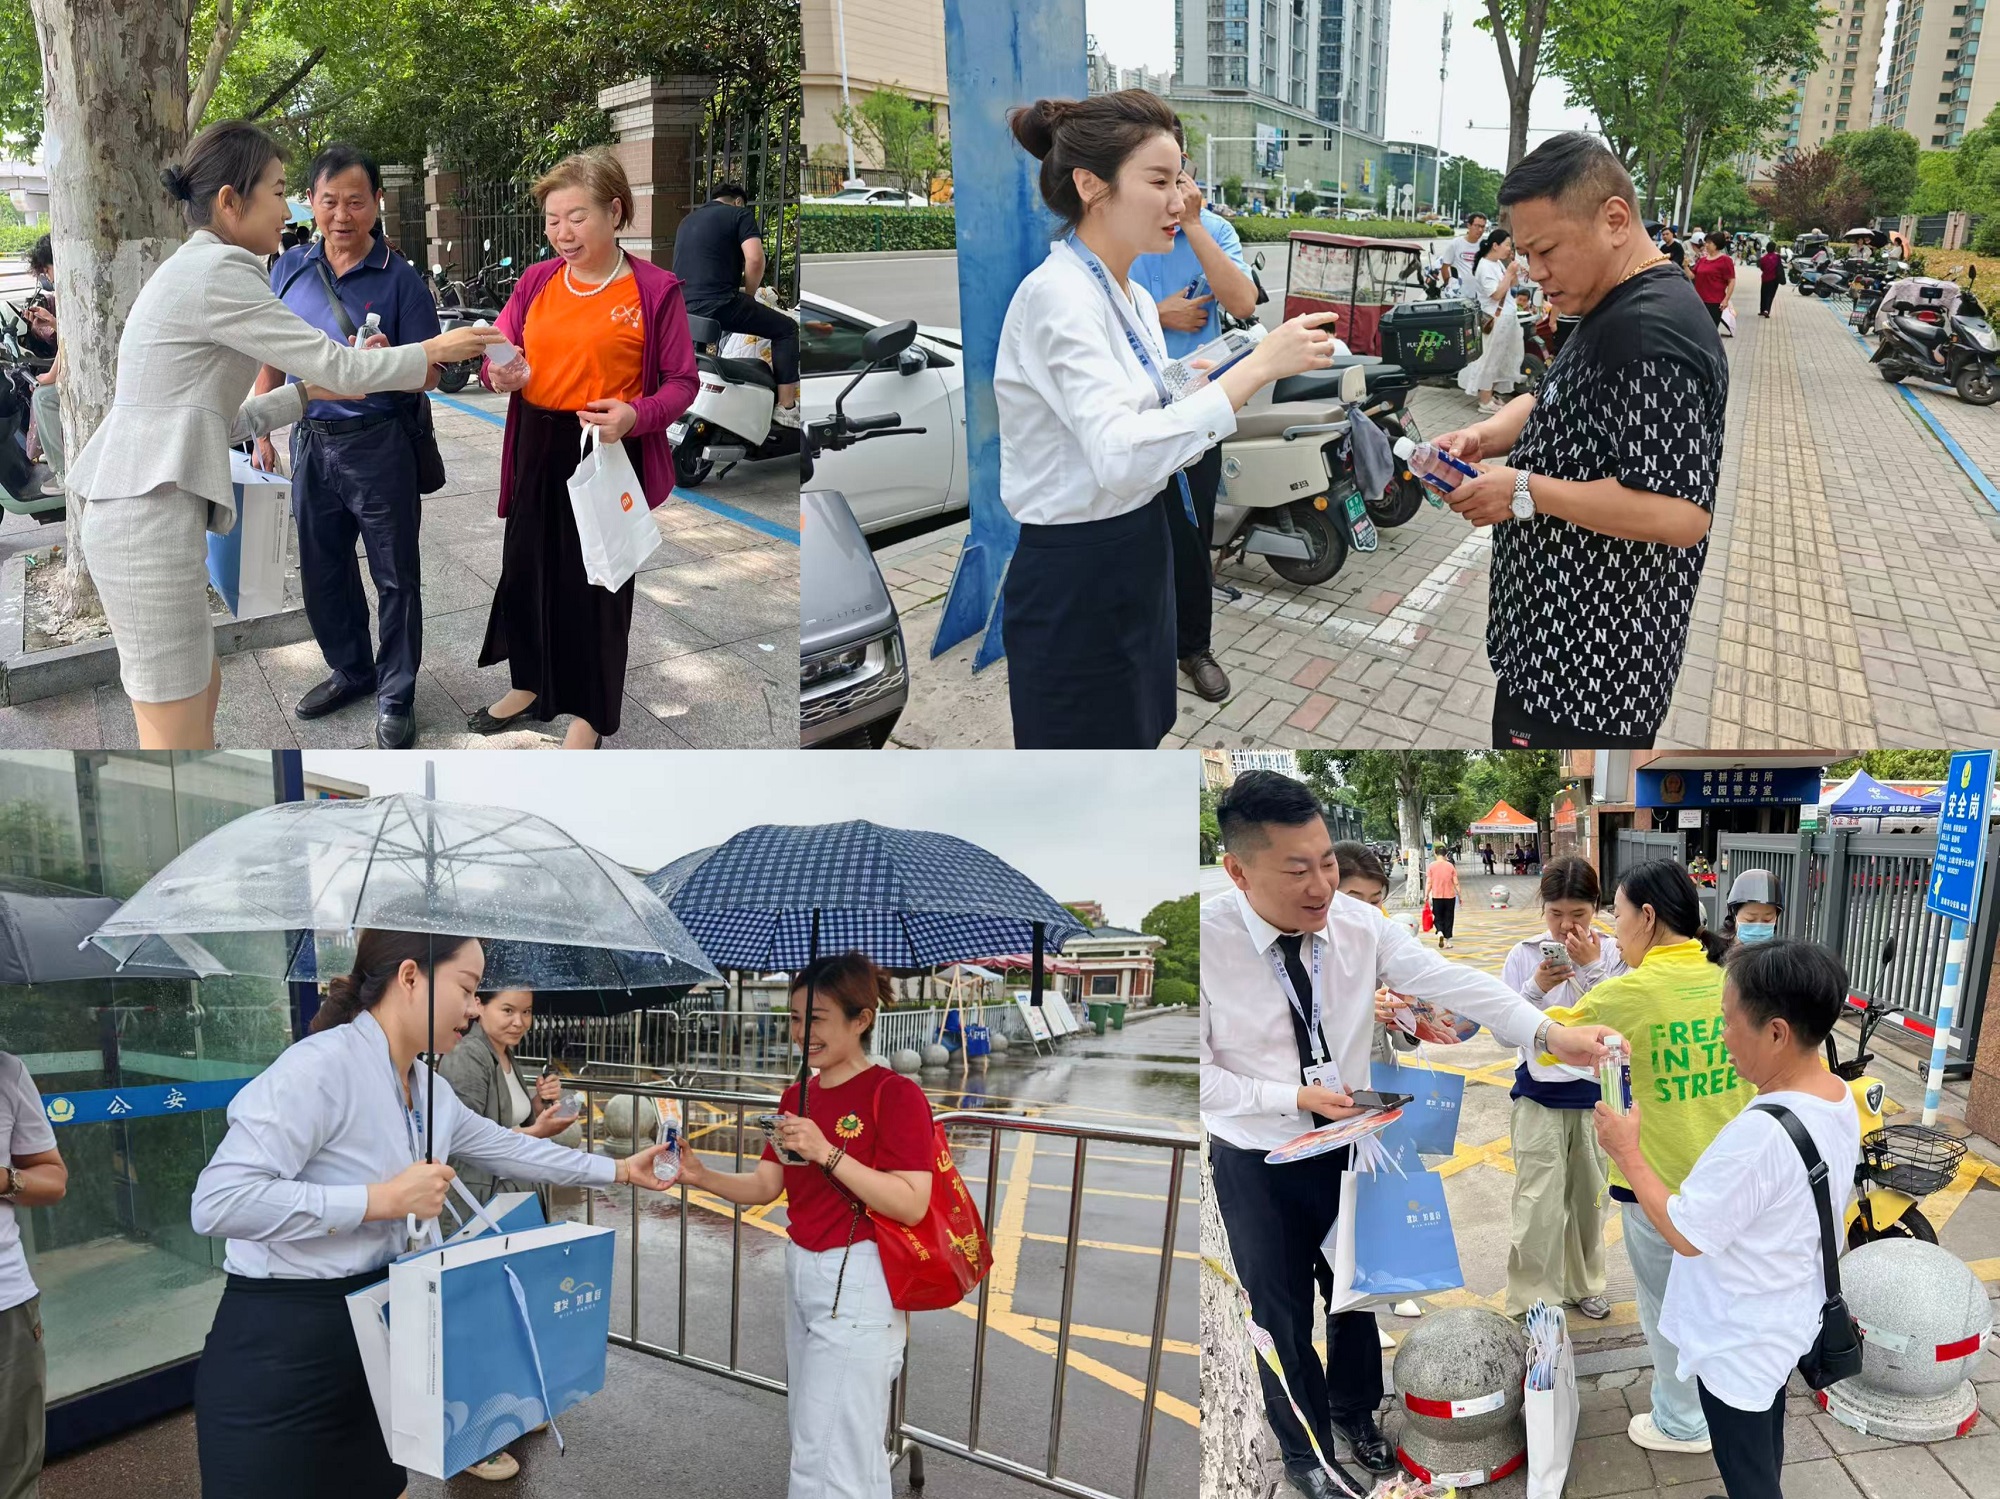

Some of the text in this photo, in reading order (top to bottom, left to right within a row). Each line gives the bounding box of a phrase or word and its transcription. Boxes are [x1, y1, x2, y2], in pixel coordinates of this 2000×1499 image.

[1642, 362, 1680, 376] N Y
[1576, 376, 1584, 388] Y
[1630, 377, 1696, 395] N Y N
[1580, 394, 1587, 410] N
[1644, 392, 1684, 408] N Y
[1602, 404, 1612, 418] N
[1628, 410, 1641, 426] N
[1661, 408, 1699, 423] Y N
[1547, 415, 1556, 430] N
[1577, 420, 1586, 434] N
[1644, 423, 1685, 440] N Y
[1552, 433, 1605, 468] Y N Y
[1586, 437, 1597, 452] N
[1628, 439, 1700, 456] N Y N
[1645, 454, 1709, 470] N Y N
[1576, 466, 1590, 480] N
[1688, 470, 1700, 486] N
[1647, 477, 1662, 491] N
[1550, 528, 1588, 548] N Y
[1520, 529, 1662, 568] N Y N Y N Y N
[1625, 540, 1634, 554] Y
[1519, 553, 1584, 575] N Y N Y
[1668, 558, 1696, 573] N Y
[1526, 570, 1534, 583] Y
[1559, 570, 1636, 594] N Y N Y
[1622, 568, 1650, 581] Y N
[1678, 572, 1688, 586] N
[1516, 577, 1581, 601] N Y N Y
[1668, 586, 1678, 601] N
[1524, 594, 1532, 607] Y
[1557, 595, 1632, 619] N Y N Y
[1658, 599, 1689, 615] Y N
[1506, 602, 1577, 626] N Y N Y
[1610, 614, 1680, 632] Y N Y N
[1510, 624, 1520, 640] N
[1536, 627, 1574, 651] N Y
[1551, 619, 1669, 645] N Y N Y N Y
[1517, 642, 1570, 676] Y N Y
[1546, 645, 1653, 672] N Y N Y N
[1608, 644, 1642, 658] Y N
[1541, 670, 1650, 698] N Y N Y N
[1605, 669, 1640, 684] Y N
[1527, 677, 1565, 700] N Y
[1536, 694, 1646, 722] N Y N Y N
[1601, 693, 1658, 710] Y N Y
[1524, 699, 1561, 723] N Y
[1596, 716, 1631, 735] Y N
[1704, 772, 1773, 783] 舜耕派出所
[1702, 785, 1772, 796] 校园警务室
[1947, 791, 1980, 821] 安全岗
[1652, 1046, 1691, 1074] IN
[107, 1088, 187, 1115] 公安
